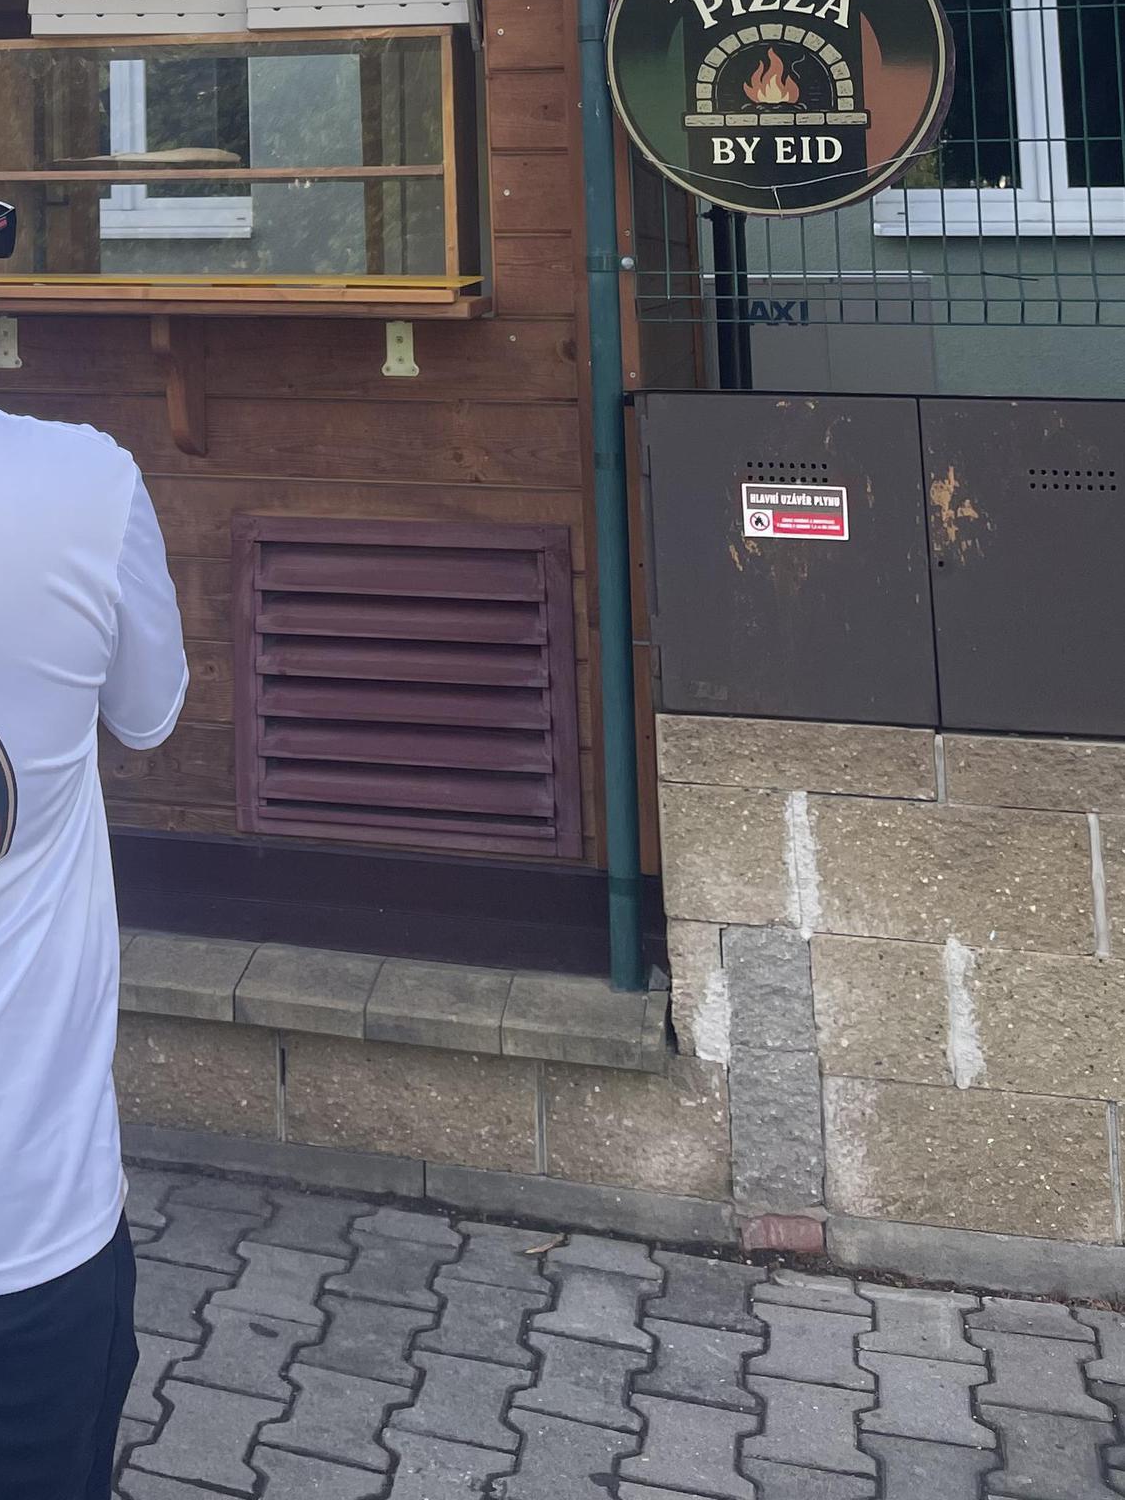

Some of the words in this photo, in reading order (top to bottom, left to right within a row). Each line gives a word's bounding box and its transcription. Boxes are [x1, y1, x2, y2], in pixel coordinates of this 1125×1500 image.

[711, 136, 761, 164] BY
[775, 135, 842, 163] EID
[749, 301, 808, 325] AXI
